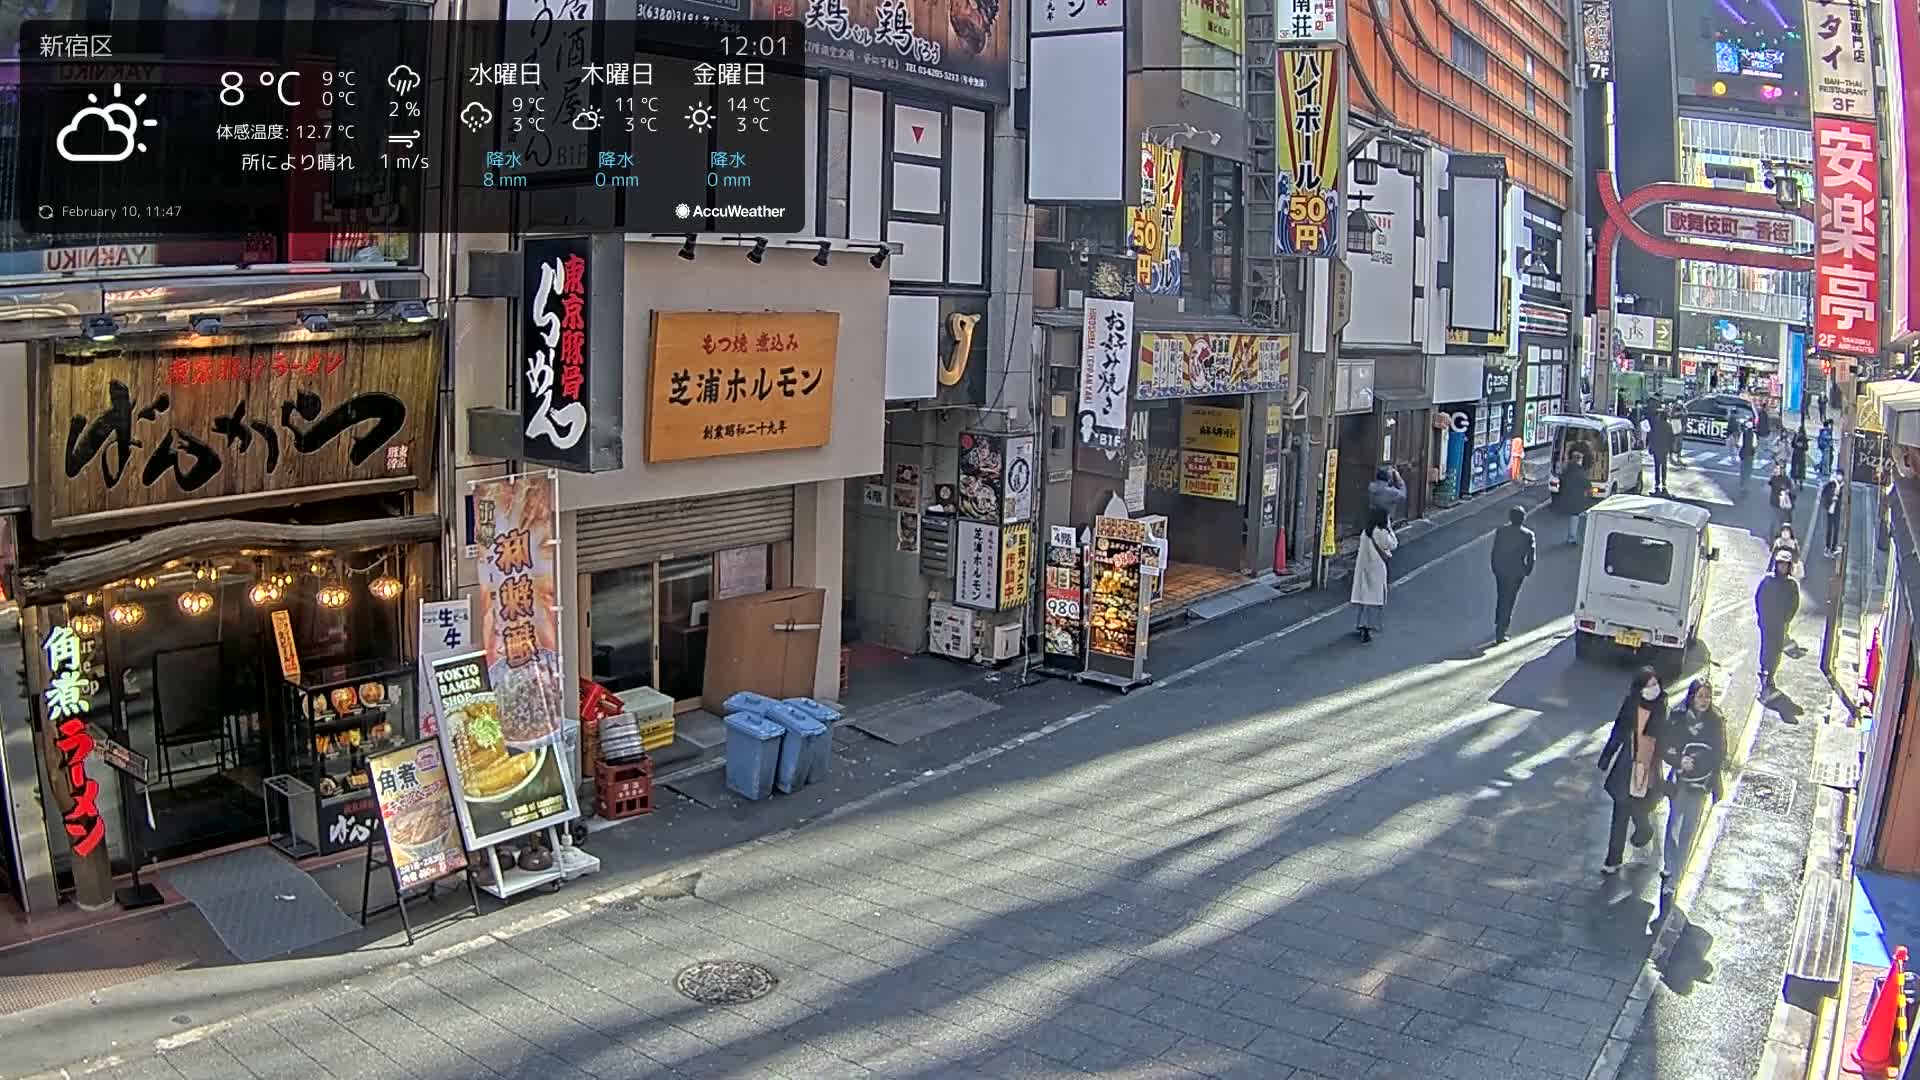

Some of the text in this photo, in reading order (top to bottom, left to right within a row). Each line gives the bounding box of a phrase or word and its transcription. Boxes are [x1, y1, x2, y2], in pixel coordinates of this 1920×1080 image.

[1589, 63, 1610, 79] 7F
[1832, 98, 1856, 112] 3F
[1294, 53, 1321, 192] ハイボール
[1289, 195, 1328, 223] 50
[1133, 220, 1157, 250] 50
[1295, 224, 1319, 251] 円
[1669, 211, 1791, 242] 歌舞伎町一番街
[1819, 126, 1876, 330] 安楽亭
[1136, 253, 1152, 288] 円
[560, 254, 585, 400] 東京豚骨
[1818, 333, 1836, 347] 2F
[756, 331, 799, 353] 煮込み
[667, 365, 823, 406] 芝浦ホルモン
[65, 379, 407, 493] ばんから
[702, 419, 788, 441] 創業昭和二十九年
[1047, 600, 1078, 617] 980
[436, 664, 480, 684] TOKYO
[440, 676, 481, 697] RAMEN
[442, 692, 473, 708] SHOP
[377, 761, 419, 796] 角煮
